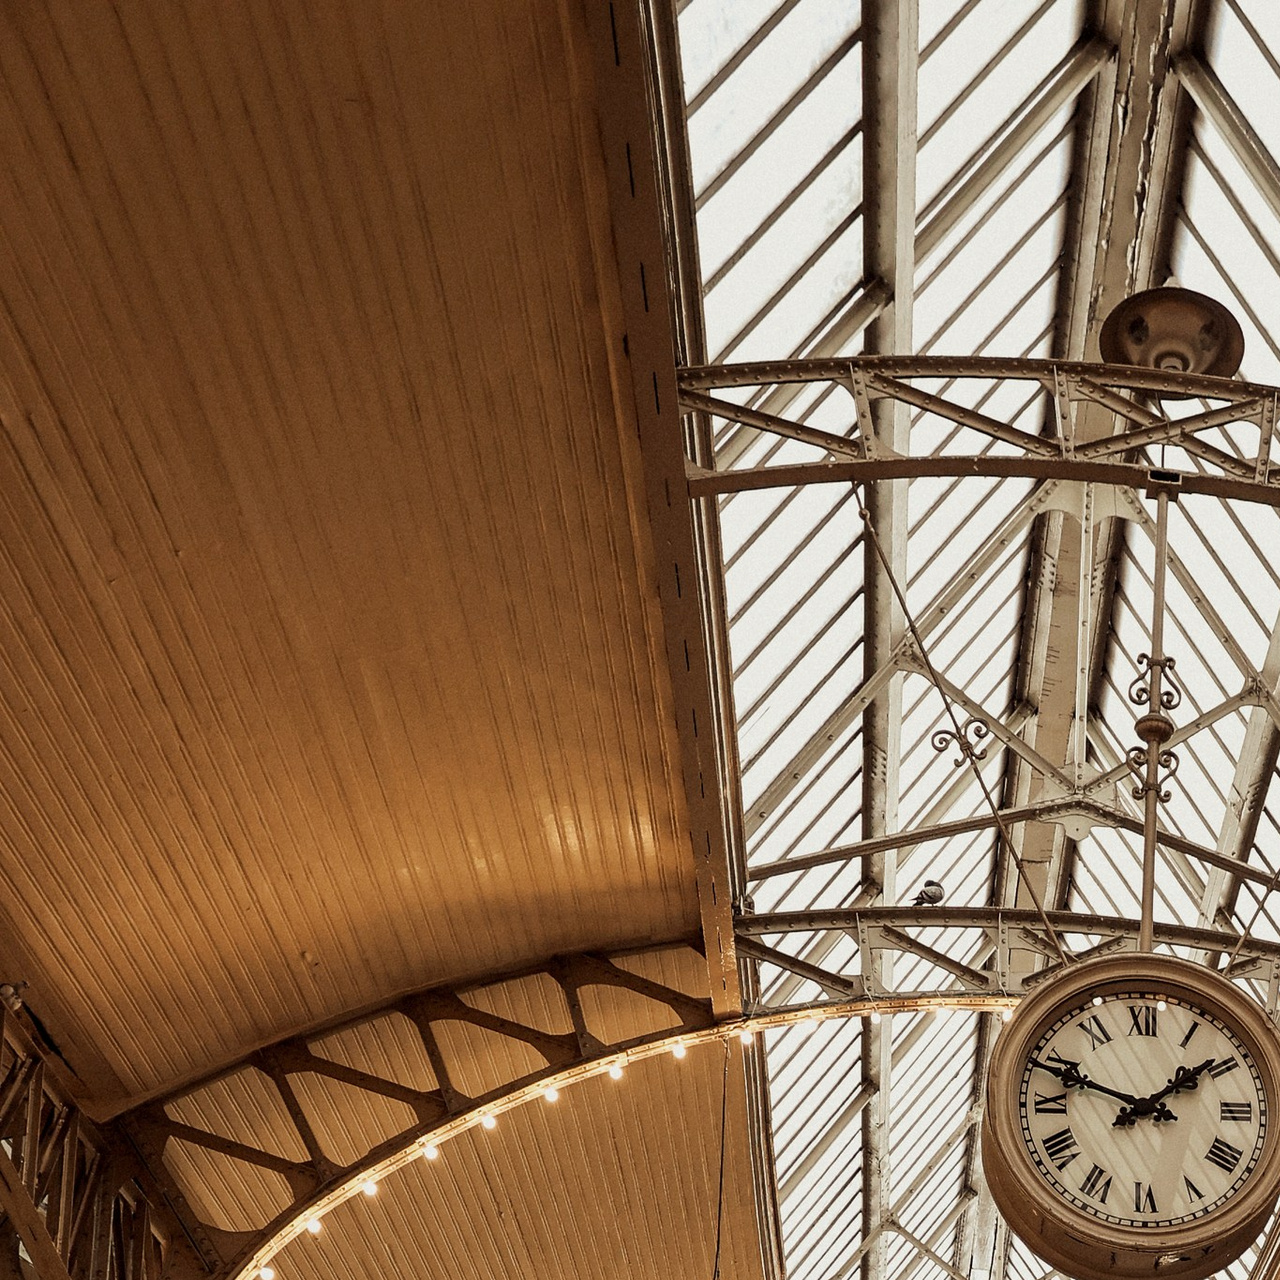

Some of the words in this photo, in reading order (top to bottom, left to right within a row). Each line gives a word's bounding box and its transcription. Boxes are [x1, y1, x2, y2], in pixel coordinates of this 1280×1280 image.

[1076, 1014, 1114, 1052] XI
[1127, 1005, 1159, 1038] XII
[1178, 1020, 1201, 1050] I
[1206, 1054, 1240, 1081] II
[1034, 1091, 1067, 1116] IX
[1220, 1100, 1251, 1123] III
[1041, 1125, 1082, 1173] VIII
[1203, 1135, 1243, 1175] IIII
[1079, 1162, 1113, 1205] VII
[1133, 1181, 1159, 1213] VI
[1183, 1175, 1205, 1204] V
